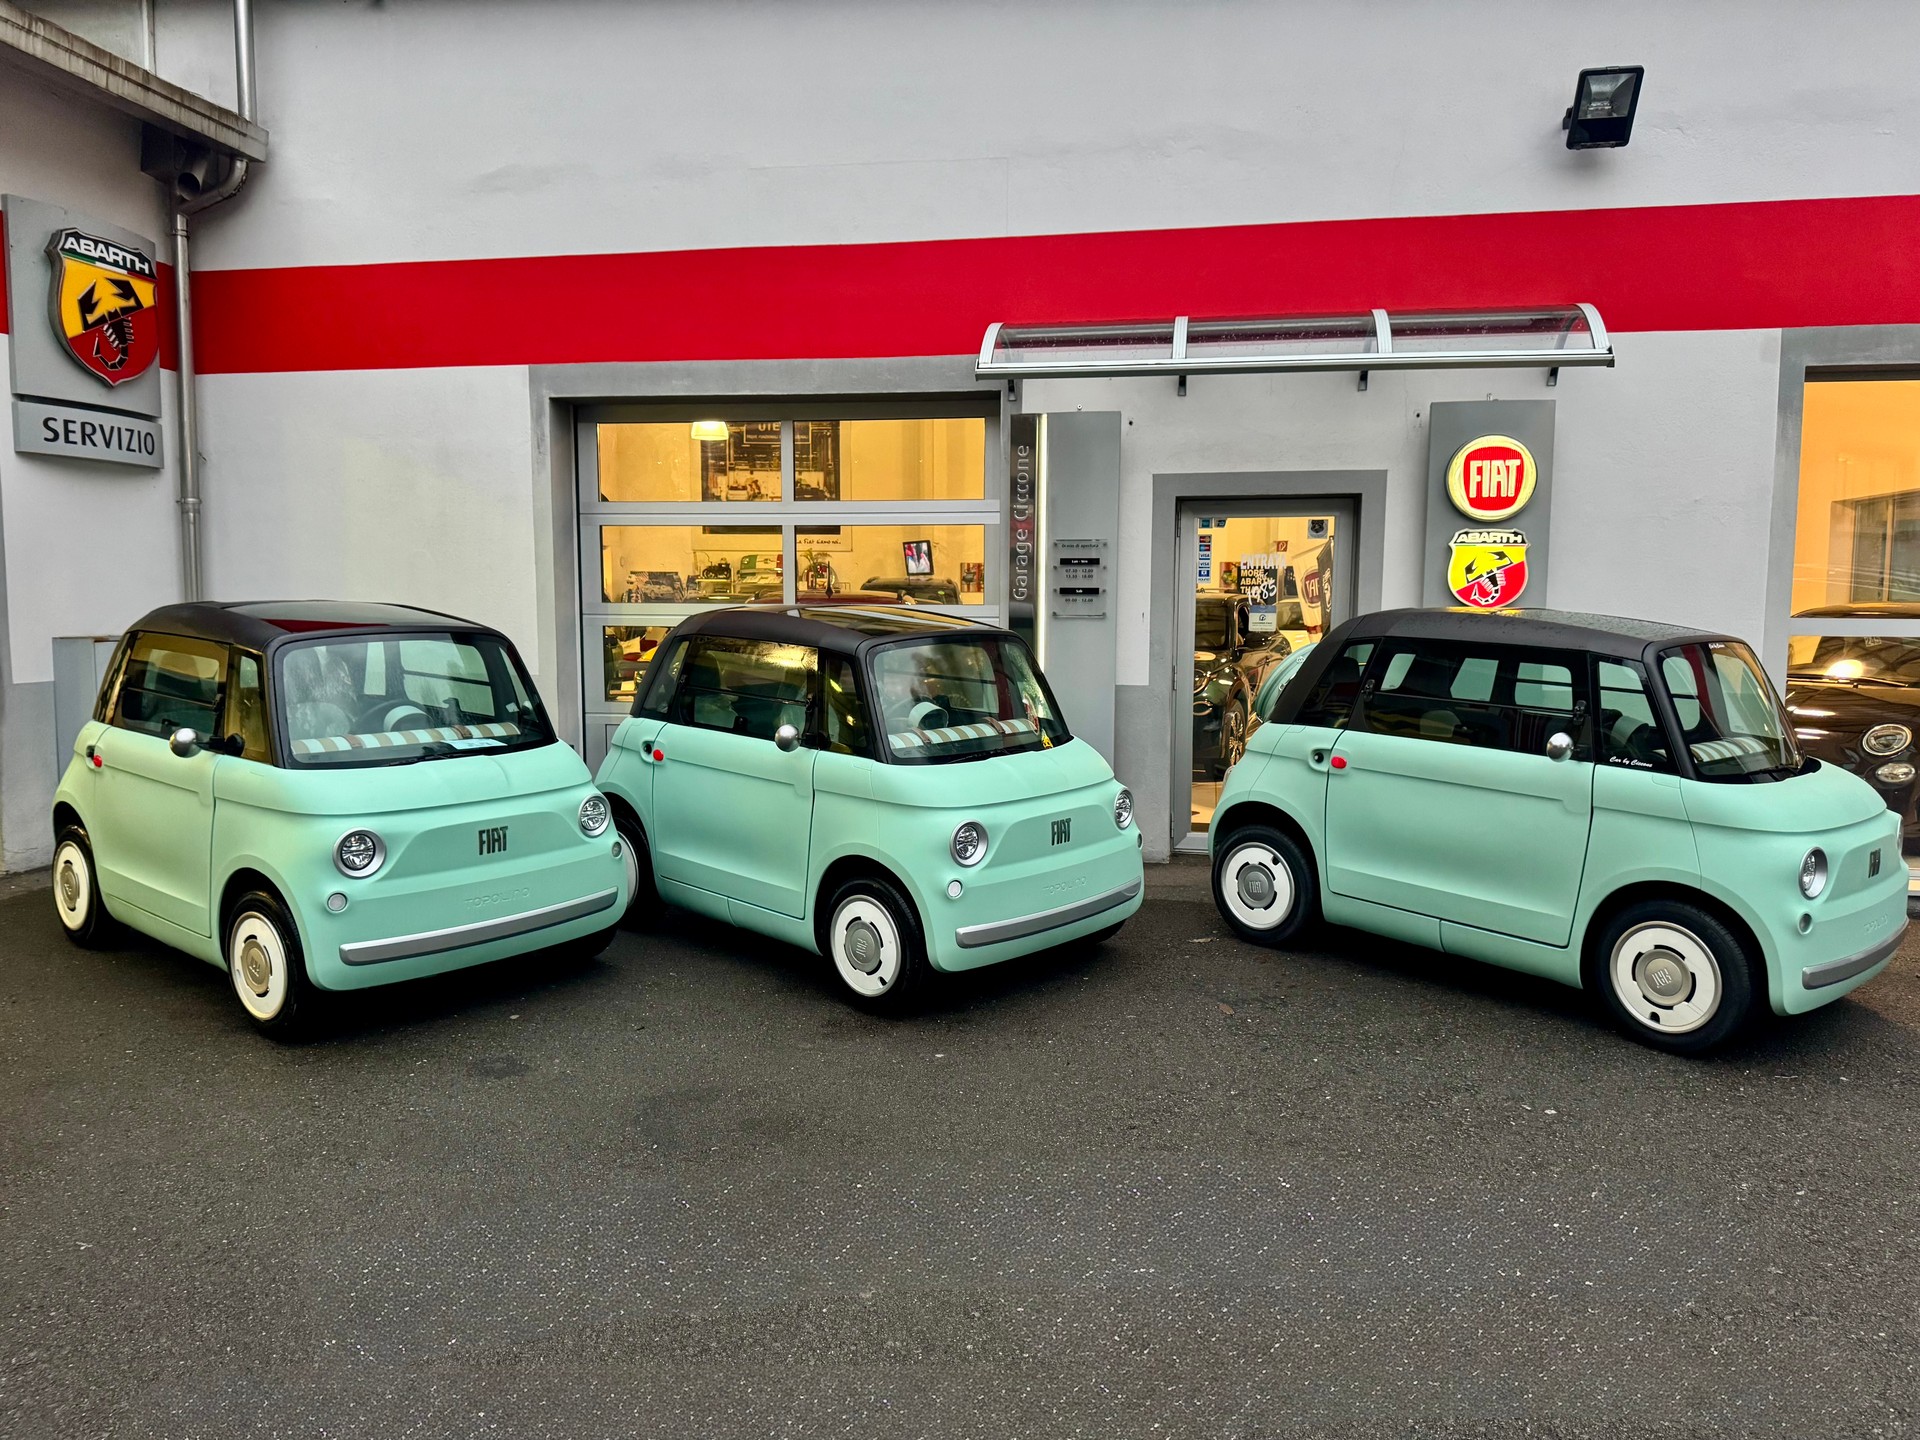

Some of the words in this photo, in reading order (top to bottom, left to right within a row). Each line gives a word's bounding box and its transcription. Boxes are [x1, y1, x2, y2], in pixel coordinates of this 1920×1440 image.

[64, 236, 149, 274] ABARTH
[43, 417, 155, 456] SERVIZIO
[1013, 445, 1030, 521] Ciccone
[1469, 459, 1521, 498] FIAT
[1456, 531, 1523, 544] ABARTH
[1012, 528, 1032, 600] Garage
[1240, 553, 1287, 570] ENTRATA
[1247, 579, 1278, 605] 1985
[478, 825, 508, 855] FIAT
[1051, 818, 1071, 845] FIAT
